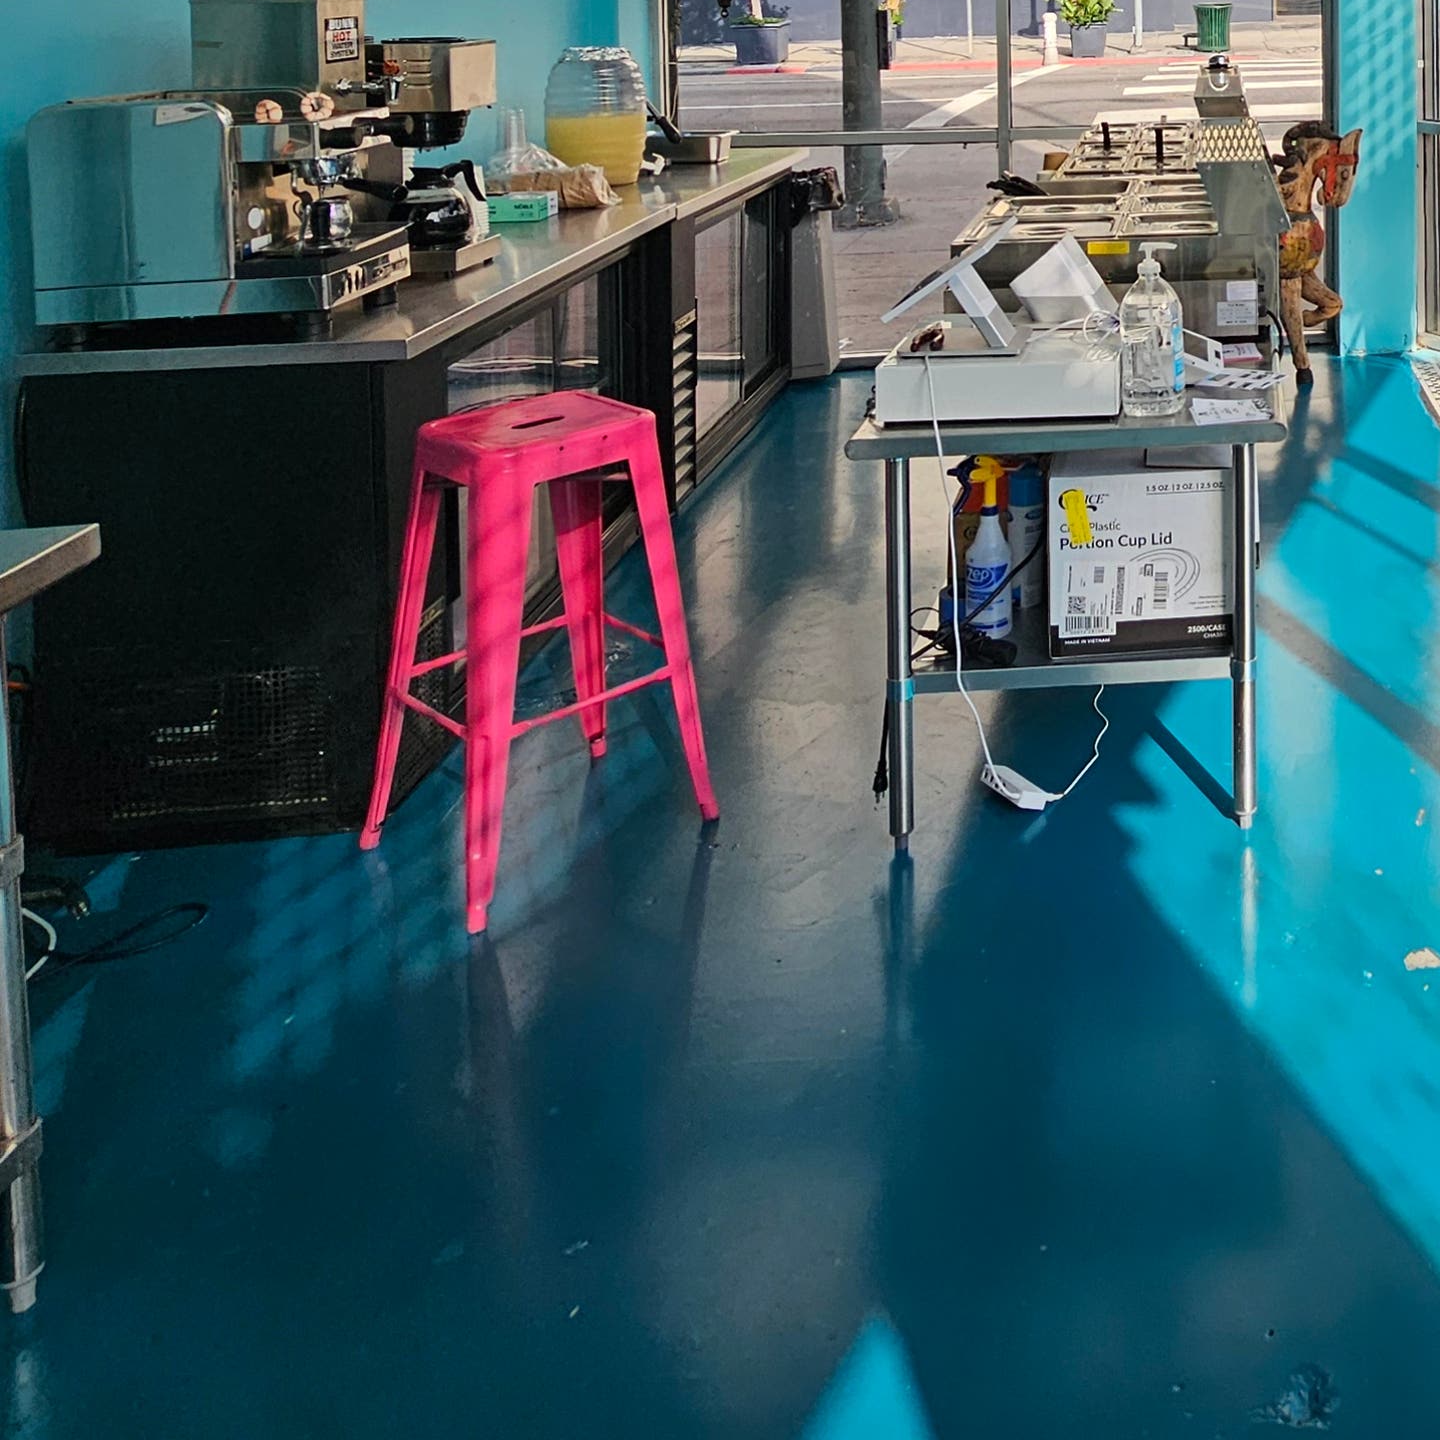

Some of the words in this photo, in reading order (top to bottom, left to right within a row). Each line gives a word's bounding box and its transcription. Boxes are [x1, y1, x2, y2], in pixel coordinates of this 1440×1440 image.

[332, 30, 352, 42] HOT
[1118, 534, 1147, 549] Cup
[1151, 531, 1173, 546] Lid
